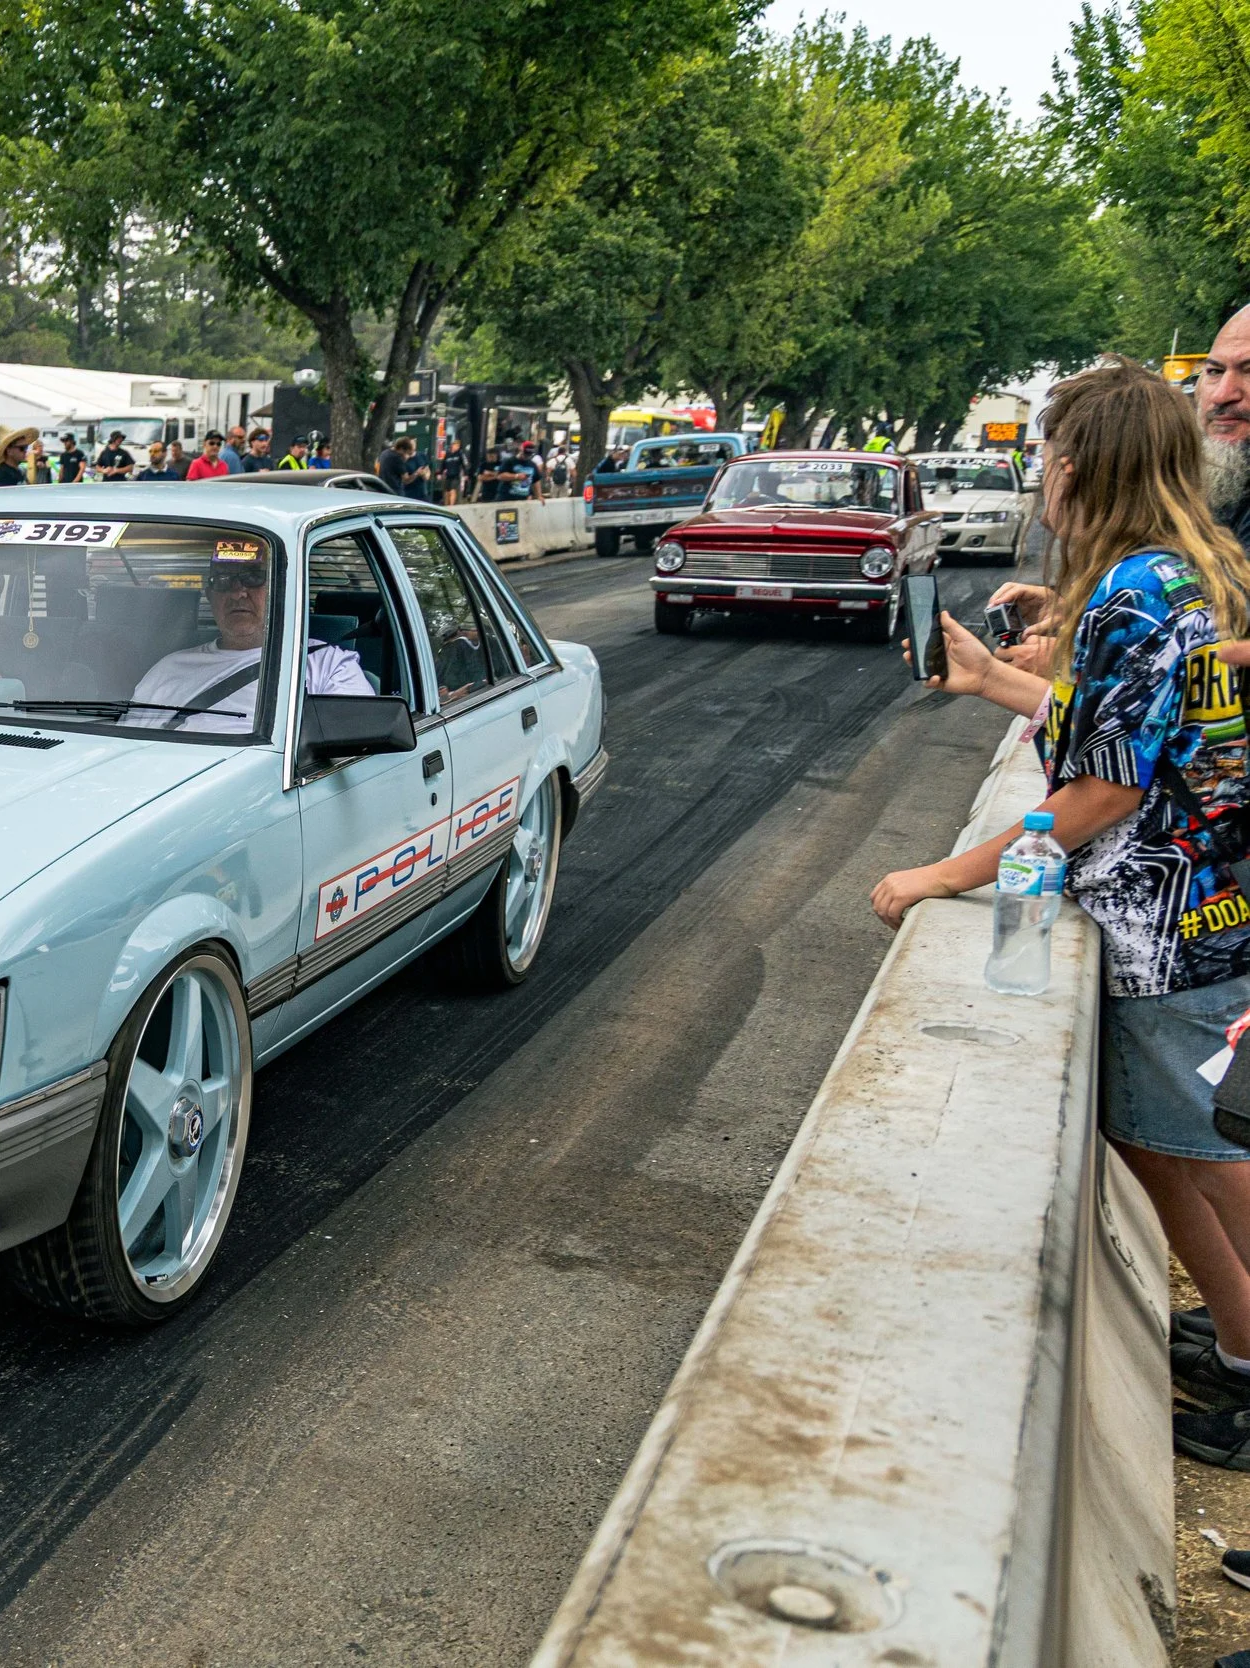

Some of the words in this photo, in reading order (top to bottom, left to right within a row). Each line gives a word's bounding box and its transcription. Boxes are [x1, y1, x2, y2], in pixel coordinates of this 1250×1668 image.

[25, 523, 111, 542] 3193
[752, 588, 784, 597] SEQUEL
[353, 787, 514, 912] POLICE
